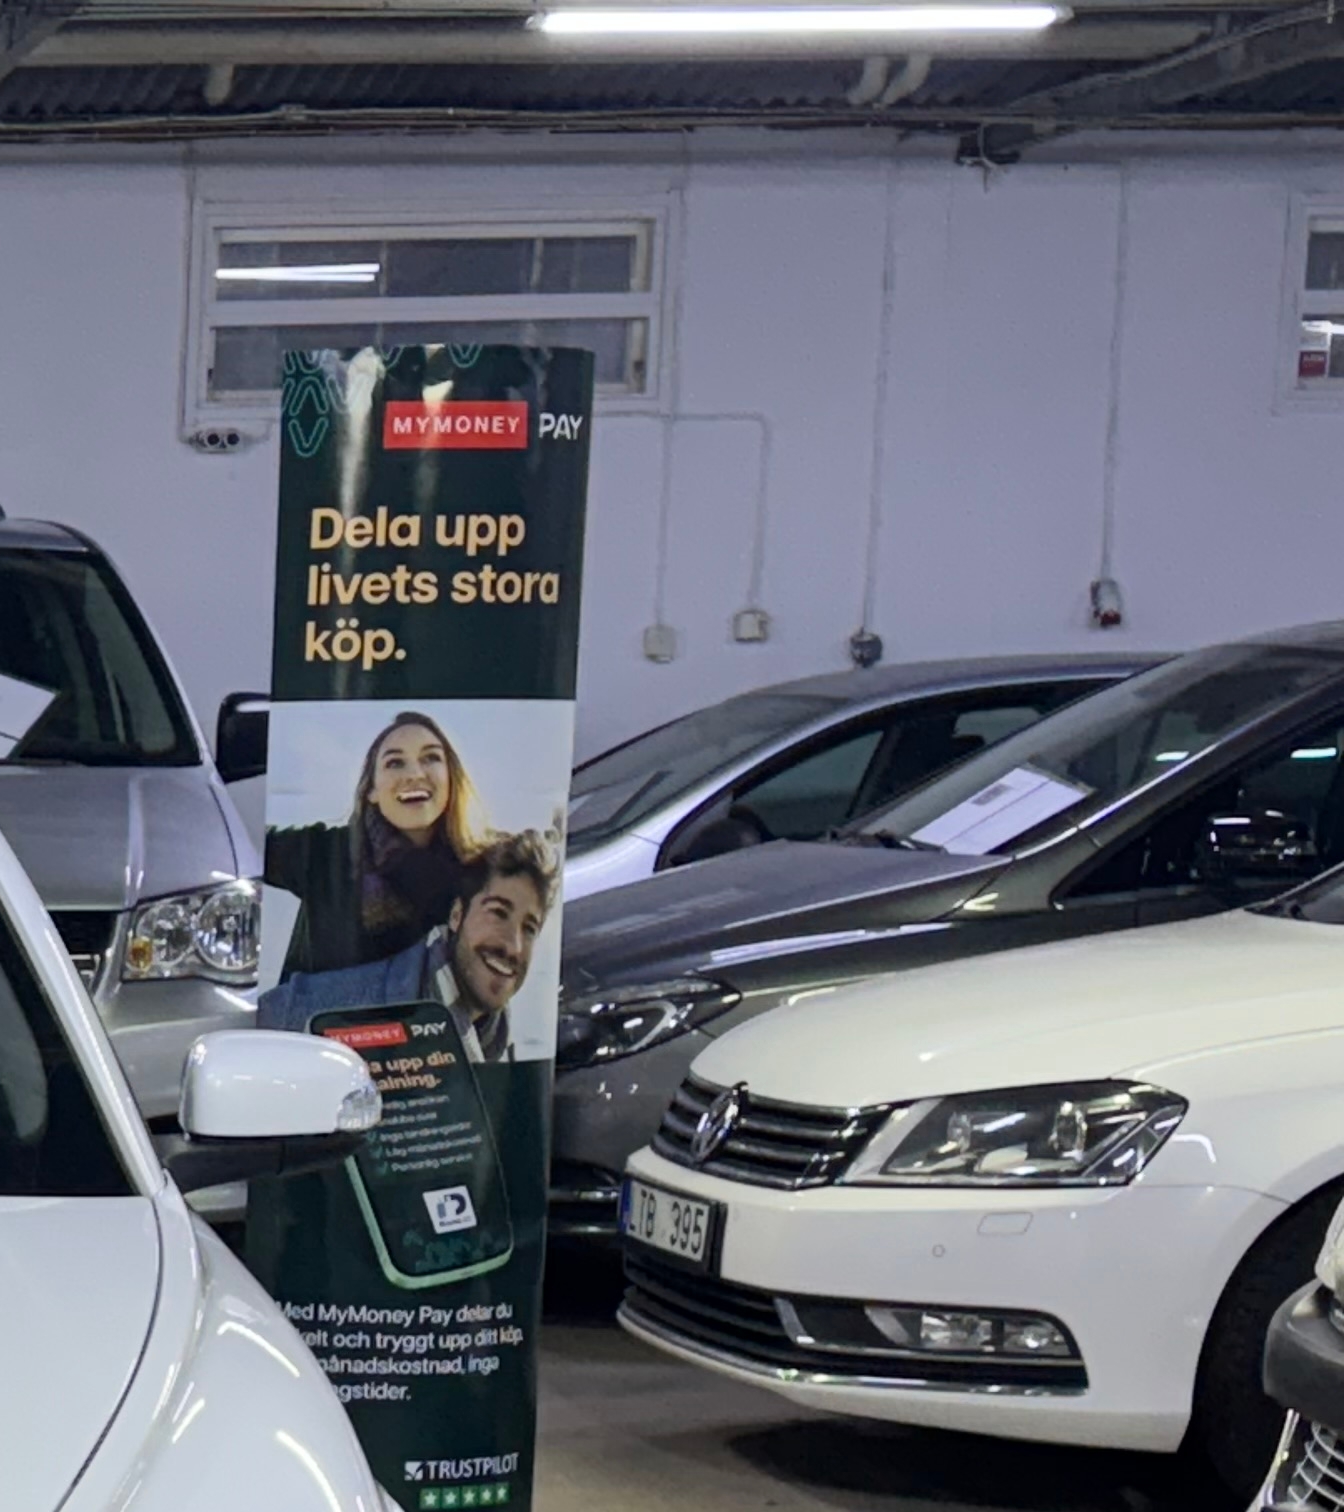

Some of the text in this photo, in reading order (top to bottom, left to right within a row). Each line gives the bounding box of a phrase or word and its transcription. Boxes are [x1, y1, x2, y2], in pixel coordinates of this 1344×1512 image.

[393, 413, 582, 440] MYMONEY PAY
[310, 506, 526, 556] Dela upp
[307, 563, 560, 605] livets stora
[305, 618, 406, 670] köp.
[410, 1021, 447, 1037] PAY
[386, 1056, 424, 1074] upp
[426, 1050, 456, 1067] din
[376, 1072, 443, 1091] alning.
[669, 1201, 704, 1254] 395
[318, 1303, 415, 1328] MyMoney
[418, 1305, 453, 1328] Pay
[455, 1304, 494, 1322] delar
[495, 1302, 513, 1319] du
[333, 1330, 371, 1348] och
[376, 1332, 435, 1354] tryggt
[438, 1333, 472, 1352] upp
[474, 1327, 499, 1346] ditt
[467, 1354, 500, 1377] inga
[333, 1381, 411, 1403] gstider.
[428, 1452, 520, 1481] TRUSTPILOT
